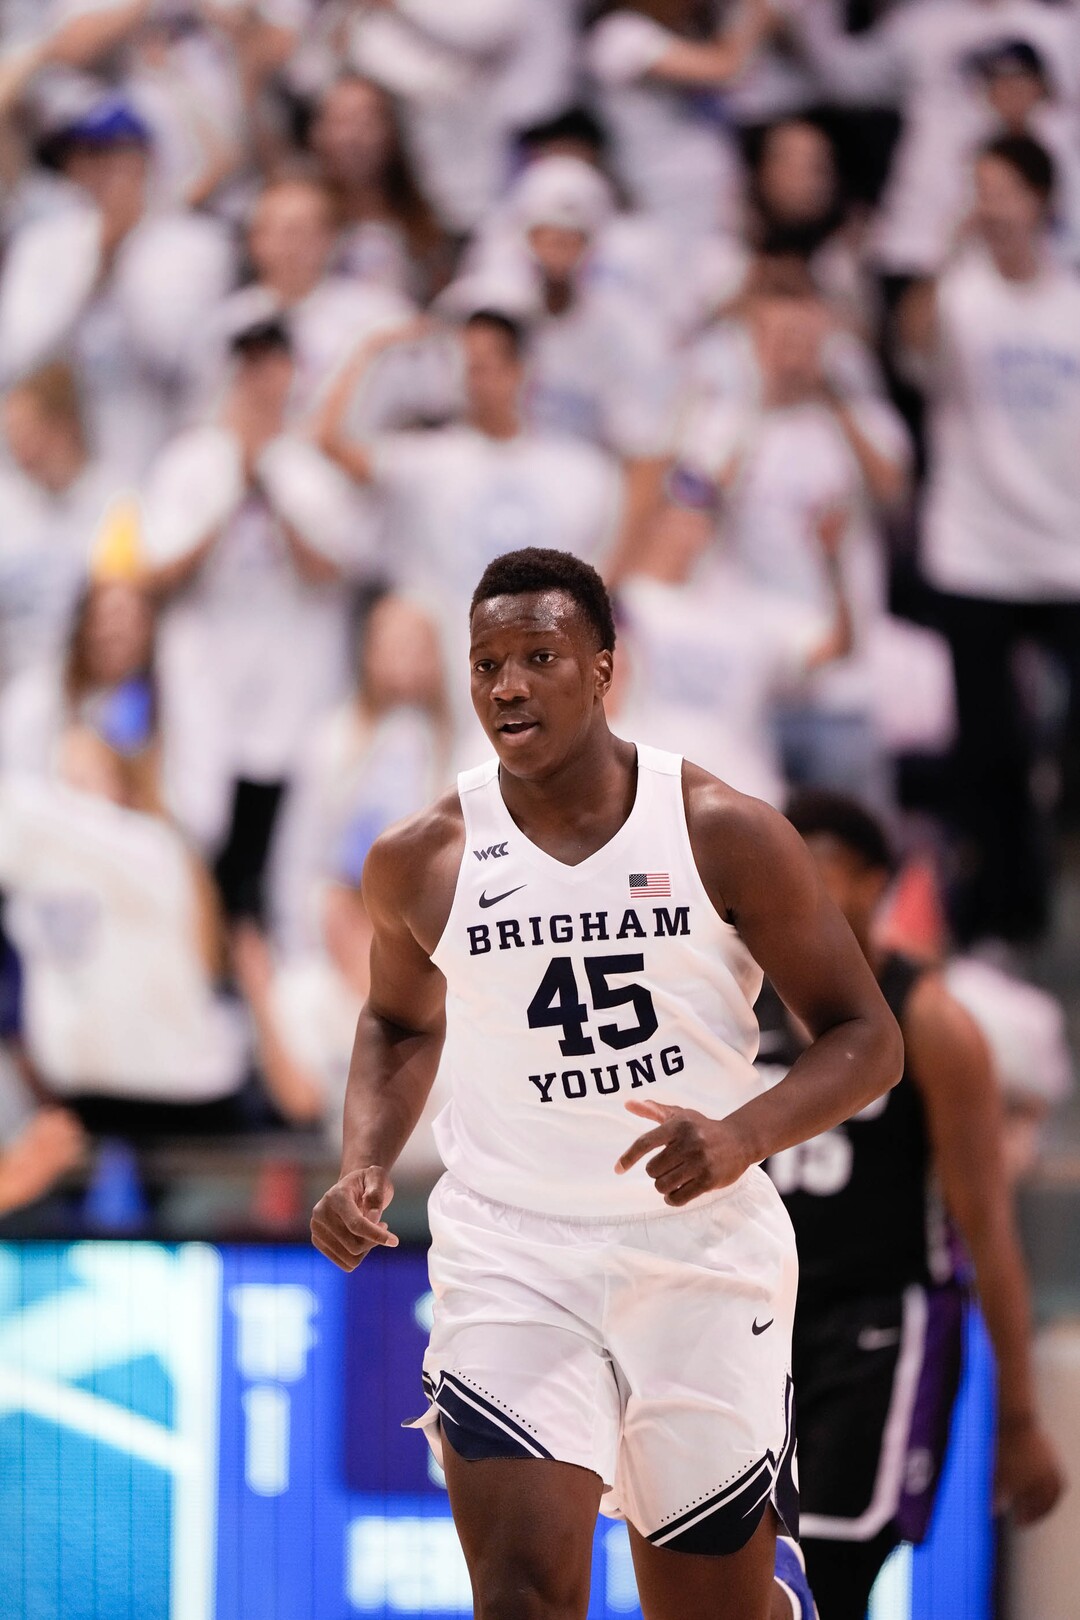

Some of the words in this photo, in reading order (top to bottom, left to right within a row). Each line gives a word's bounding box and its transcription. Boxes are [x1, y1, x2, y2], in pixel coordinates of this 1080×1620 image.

[473, 841, 509, 861] WCC
[467, 906, 691, 956] BRIGHAM
[526, 953, 659, 1057] 45
[528, 1045, 685, 1103] YOUNG
